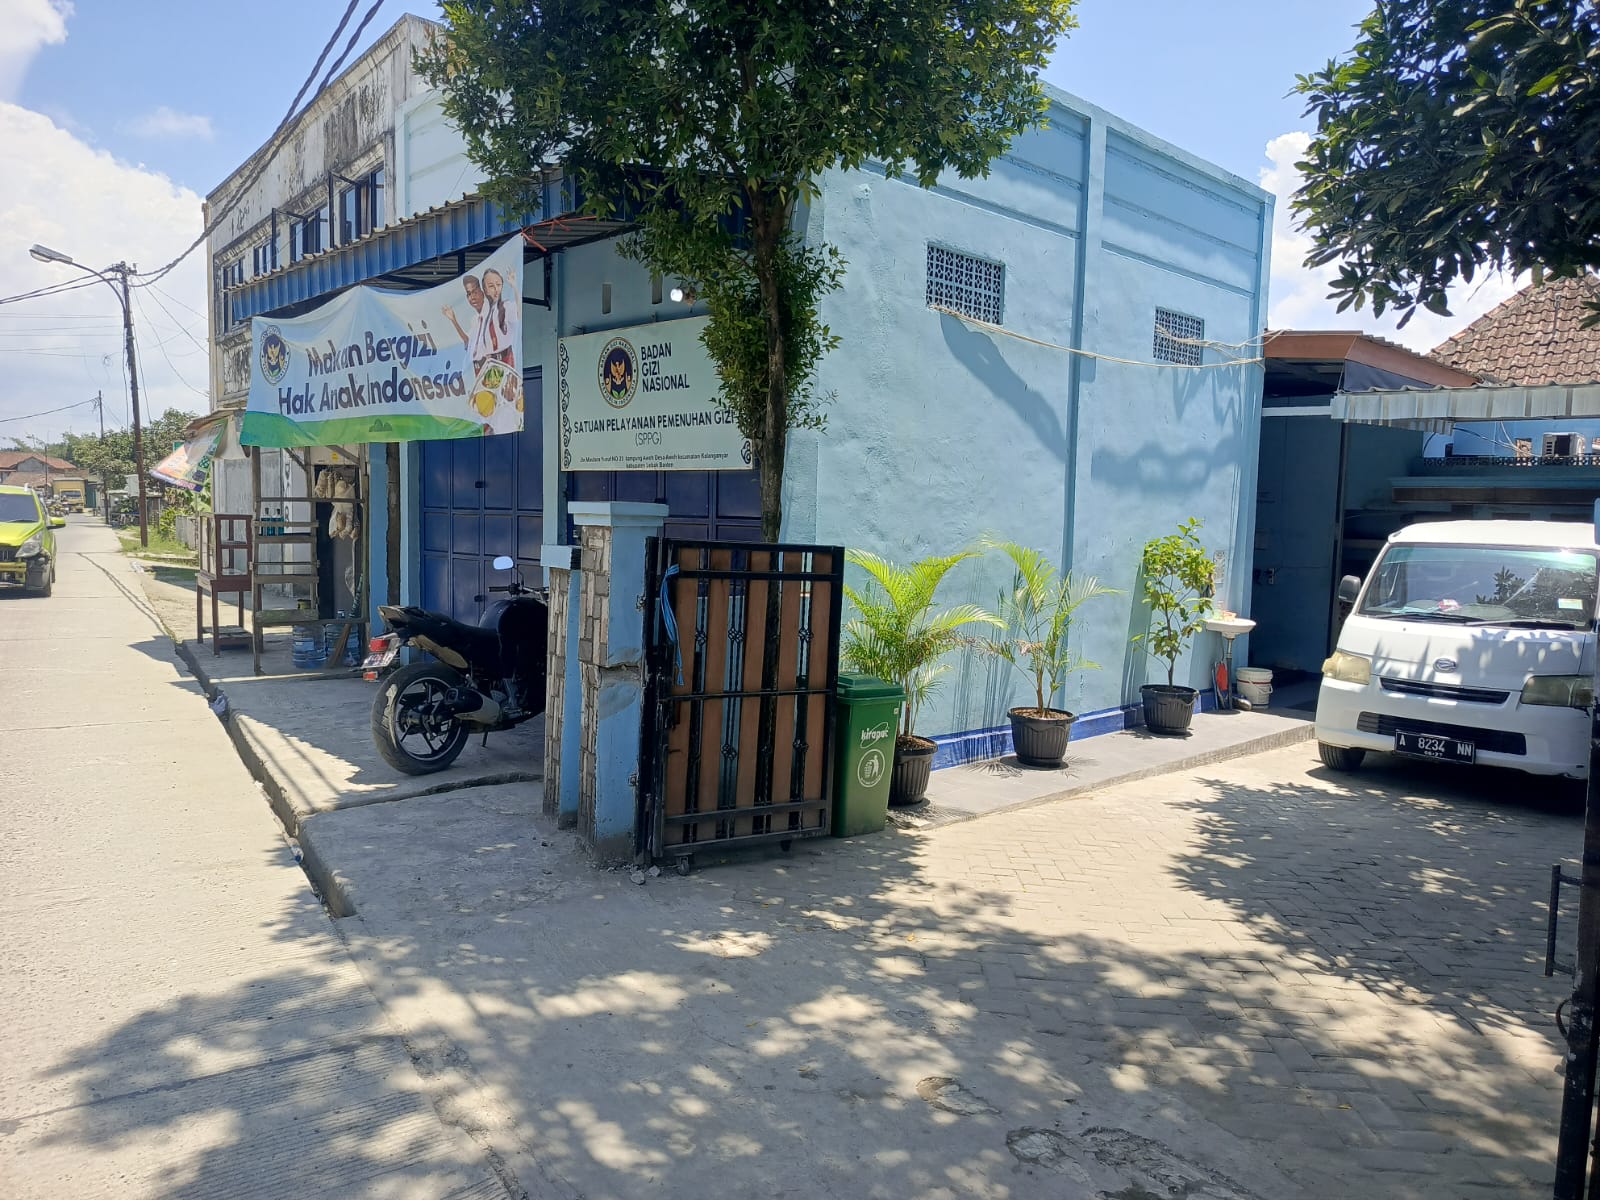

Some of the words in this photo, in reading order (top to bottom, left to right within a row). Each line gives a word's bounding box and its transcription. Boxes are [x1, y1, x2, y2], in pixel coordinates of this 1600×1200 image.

[306, 340, 364, 377] Makan
[364, 320, 437, 369] Bergizi
[641, 342, 672, 360] BADAN
[641, 360, 660, 376] GIZI
[278, 382, 316, 415] Hak
[319, 372, 365, 412] Anak
[366, 361, 466, 405] Indonesia
[642, 374, 690, 392] NASIONAL
[574, 419, 604, 433] SATUAN
[606, 416, 655, 432] PELAYANAN
[657, 412, 711, 428] PEMENUHAN
[713, 410, 734, 424] GIZI
[635, 431, 662, 446] (SPPG)
[1399, 734, 1406, 746] A
[1417, 737, 1446, 752] 8234
[1457, 743, 1472, 756] NN
